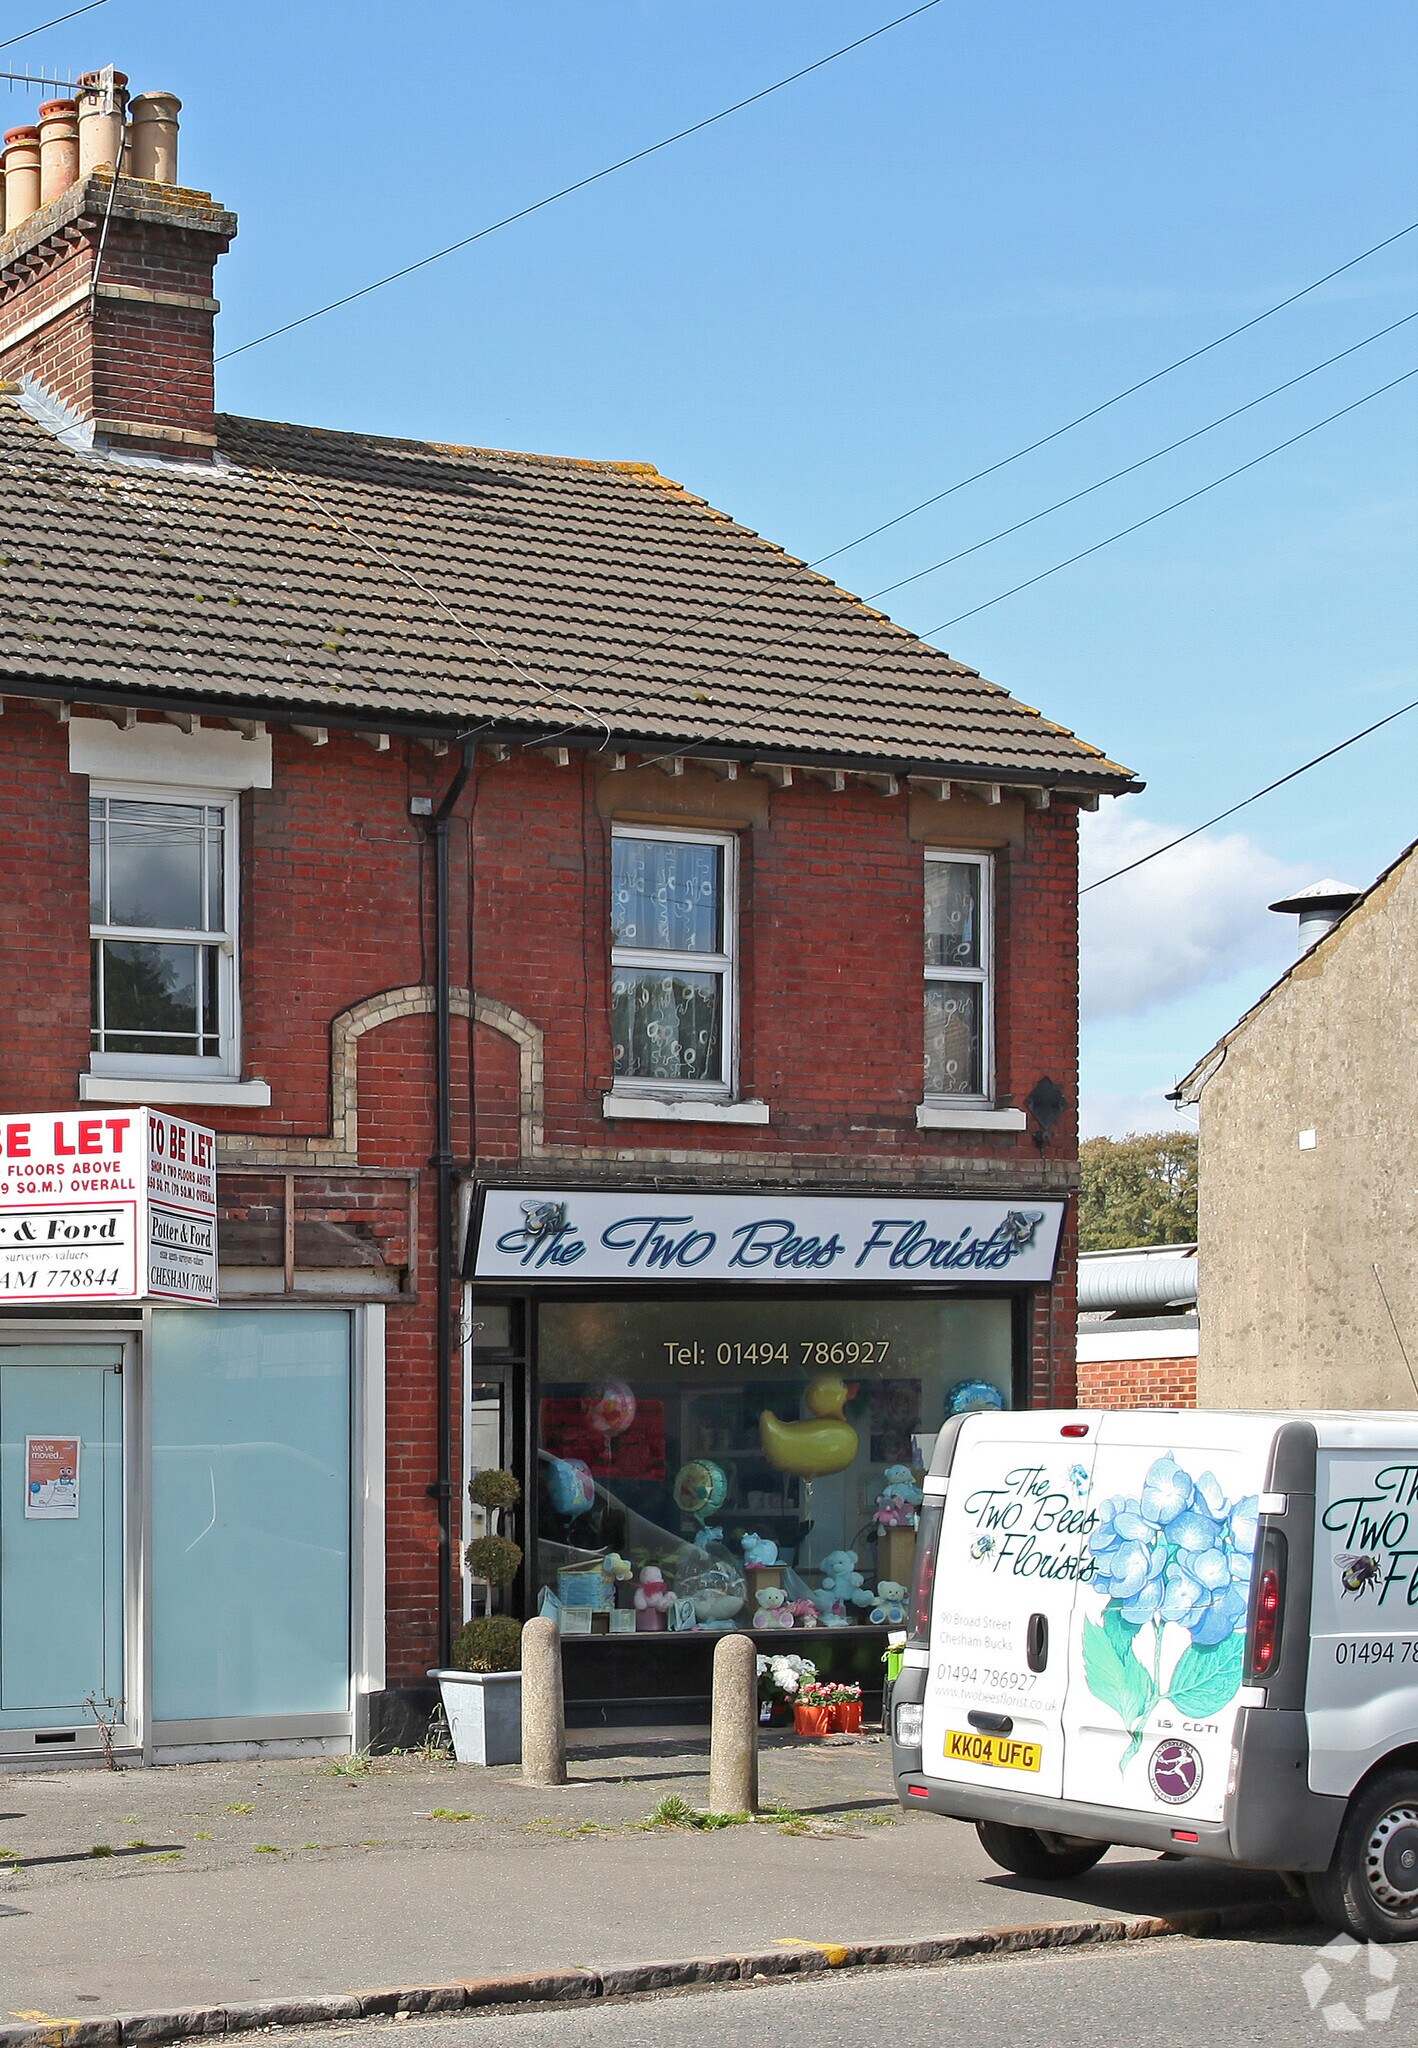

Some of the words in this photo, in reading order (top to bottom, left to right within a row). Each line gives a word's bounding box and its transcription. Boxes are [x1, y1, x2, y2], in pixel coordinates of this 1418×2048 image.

[54, 1118, 130, 1156] LET
[149, 1116, 165, 1156] TO
[169, 1123, 186, 1163] BE
[191, 1130, 213, 1170] LET
[8, 1163, 65, 1177] FLOORS
[72, 1161, 121, 1174] ABOVE
[17, 1179, 63, 1194] SQ.M.)
[71, 1178, 136, 1192] OVERALL
[13, 1220, 37, 1241] &
[47, 1217, 117, 1240] Ford
[152, 1216, 179, 1241] Potter
[180, 1223, 188, 1244] &
[190, 1225, 211, 1248] Ford
[496, 1221, 587, 1269] The
[728, 1218, 846, 1270] Bees
[854, 1219, 1019, 1271] Florists
[47, 1267, 119, 1288] 778844
[150, 1265, 190, 1290] CHESHAM
[664, 1342, 705, 1366] Tel:
[716, 1341, 789, 1366] 01494
[800, 1340, 890, 1365] 786927
[31, 1443, 54, 1452] we've
[1004, 1464, 1050, 1498] The
[1030, 1493, 1100, 1534] Bees
[993, 1533, 1100, 1582] Florists
[940, 1612, 952, 1625] 90
[953, 1613, 981, 1628] Broad
[983, 1616, 1012, 1631] Street
[939, 1631, 982, 1647] Chesham
[984, 1635, 1013, 1651] Bucks
[1335, 1641, 1395, 1665] 01494
[937, 1663, 978, 1683] 01494
[982, 1668, 1037, 1691] 786927
[951, 1733, 993, 1761] KK04
[998, 1741, 1034, 1767] UFG
